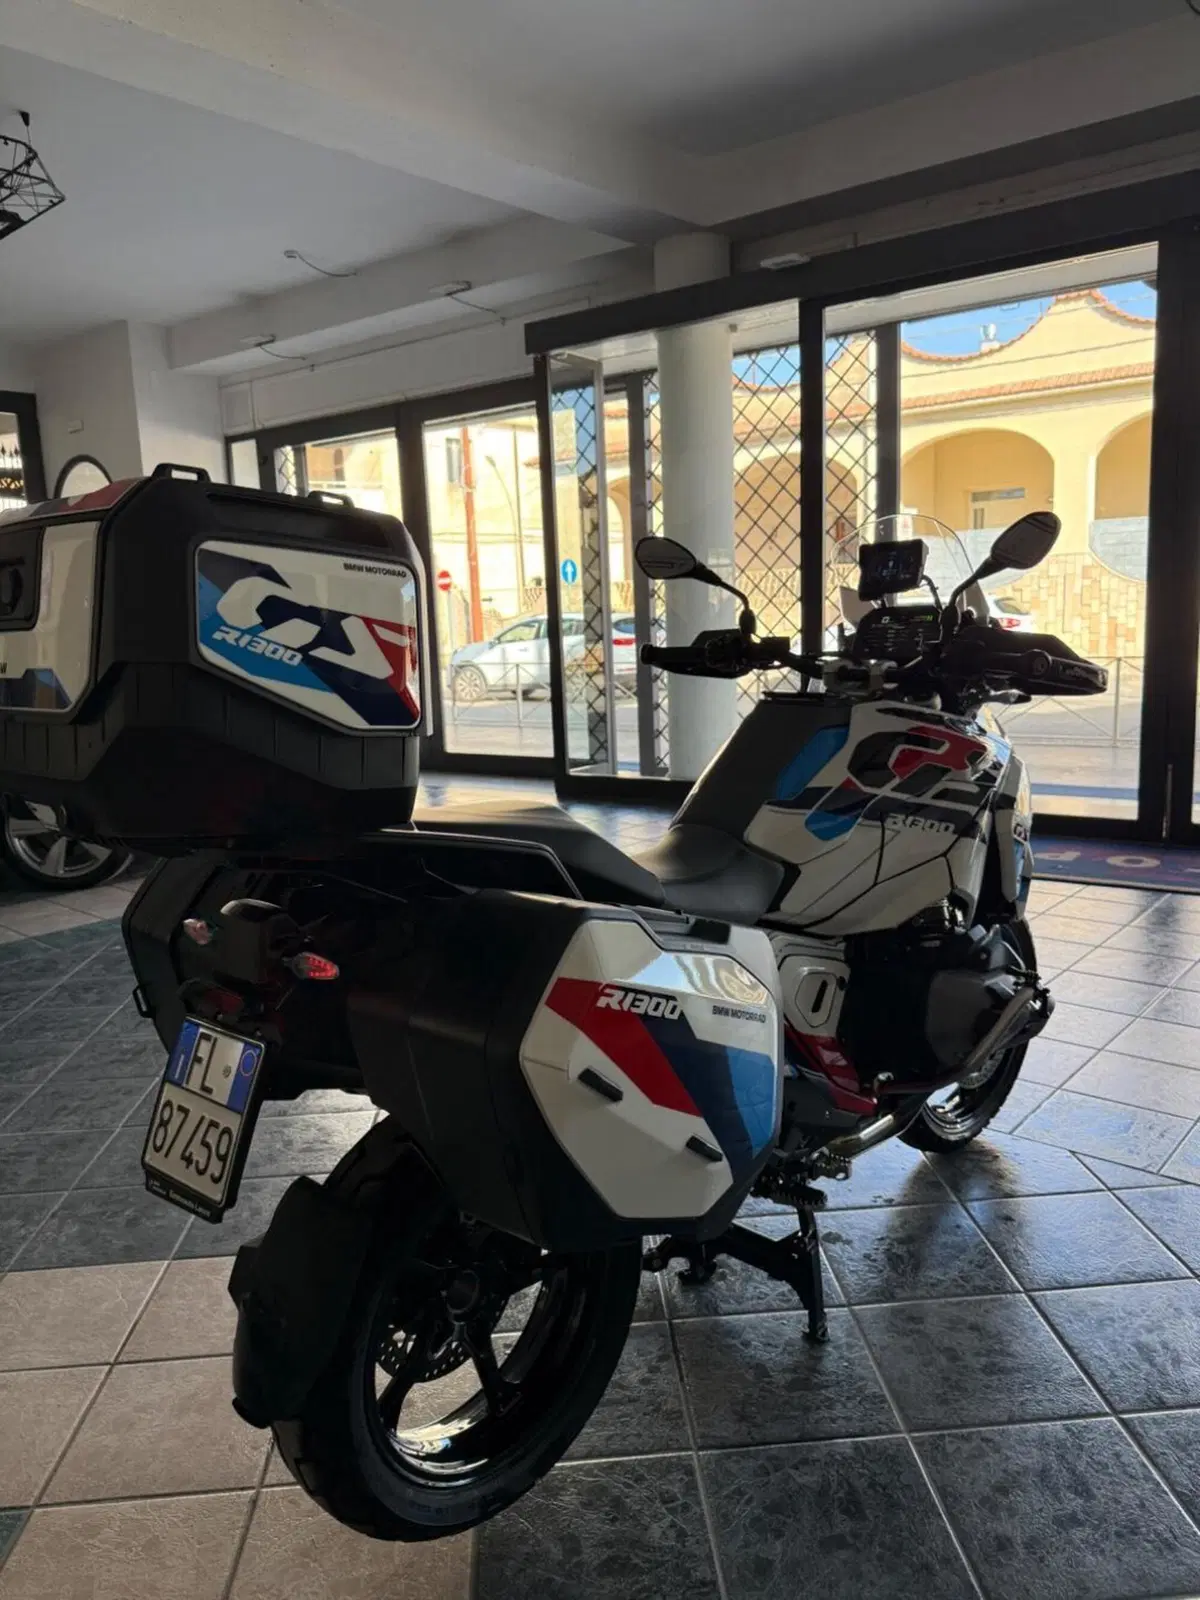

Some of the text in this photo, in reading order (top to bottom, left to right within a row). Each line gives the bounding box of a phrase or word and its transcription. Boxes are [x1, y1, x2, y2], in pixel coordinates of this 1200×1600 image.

[343, 562, 407, 579] BMW MOTORRAD
[212, 626, 303, 667] R1300
[597, 983, 683, 1020] R1300
[712, 1004, 766, 1024] BMW MOTORRAD
[186, 1032, 218, 1094] FL
[151, 1099, 234, 1185] 87459
